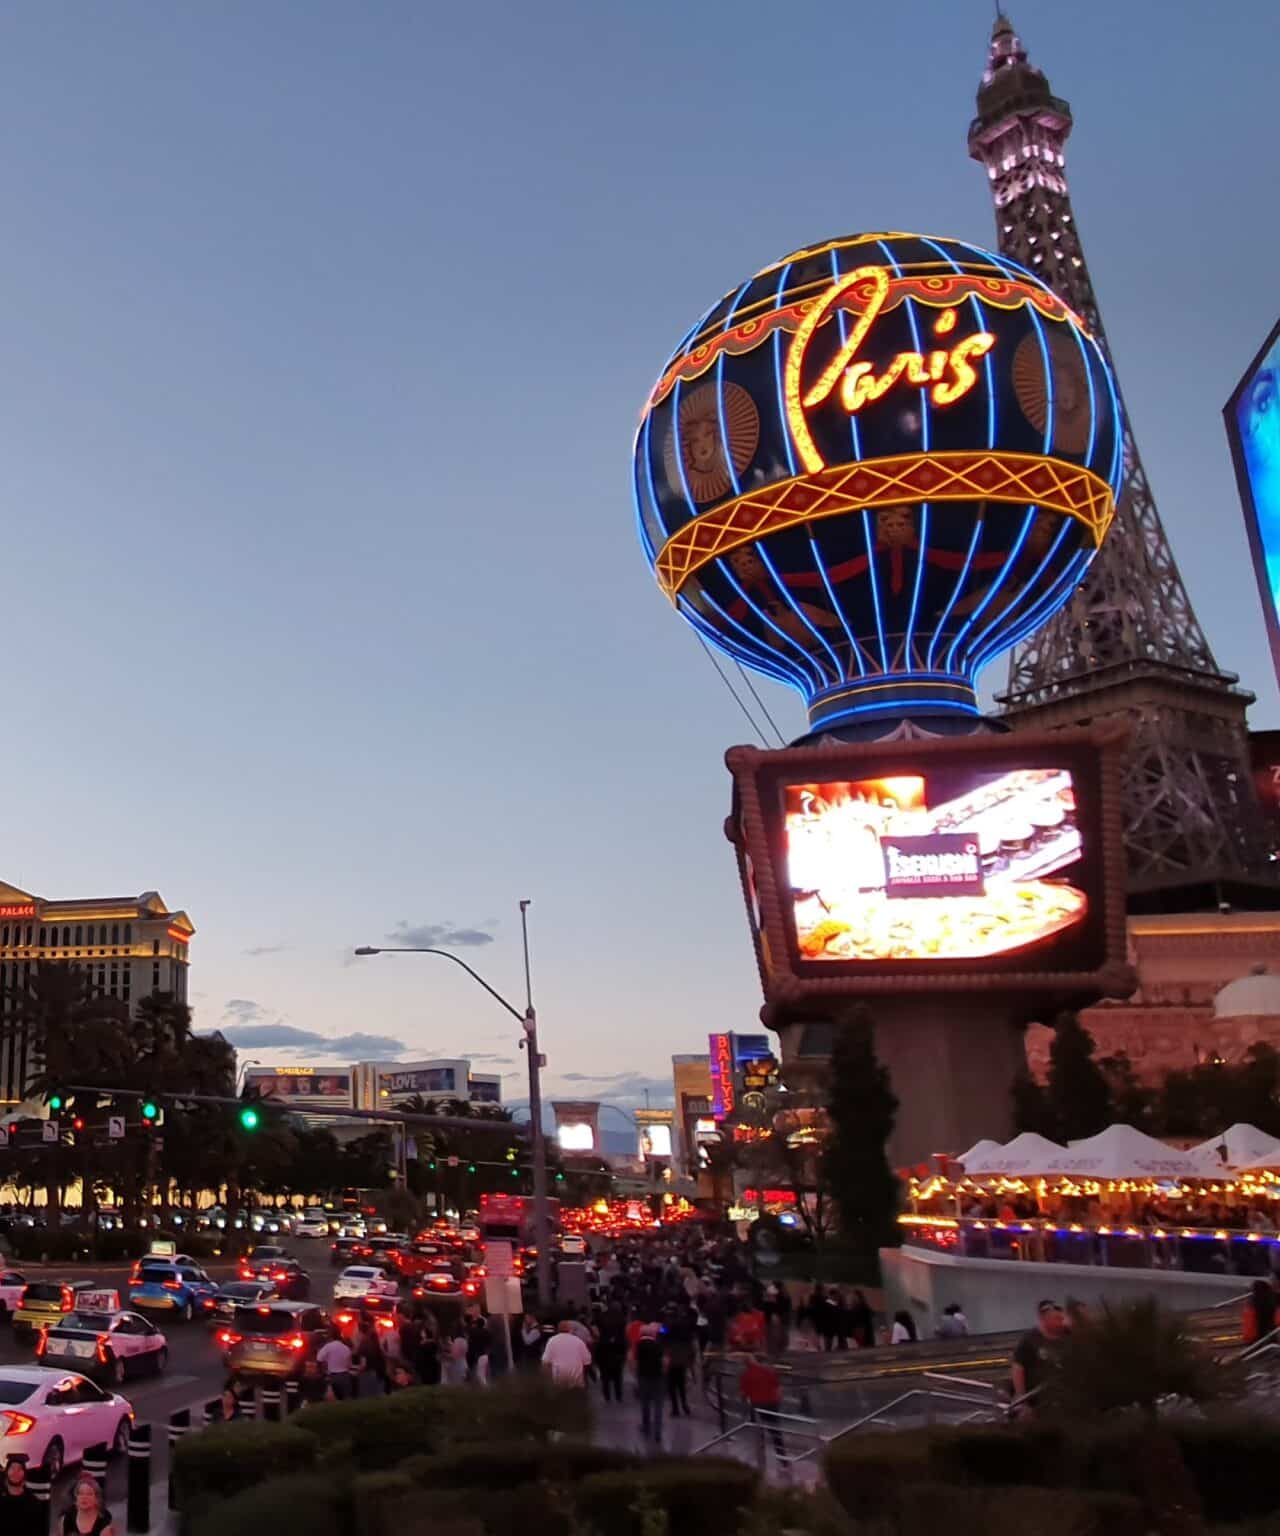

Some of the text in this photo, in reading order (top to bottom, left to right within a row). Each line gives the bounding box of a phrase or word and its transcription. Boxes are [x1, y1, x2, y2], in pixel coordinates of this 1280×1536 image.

[785, 265, 995, 474] Paris
[0, 906, 35, 916] PALACE
[391, 1073, 417, 1090] LOVE
